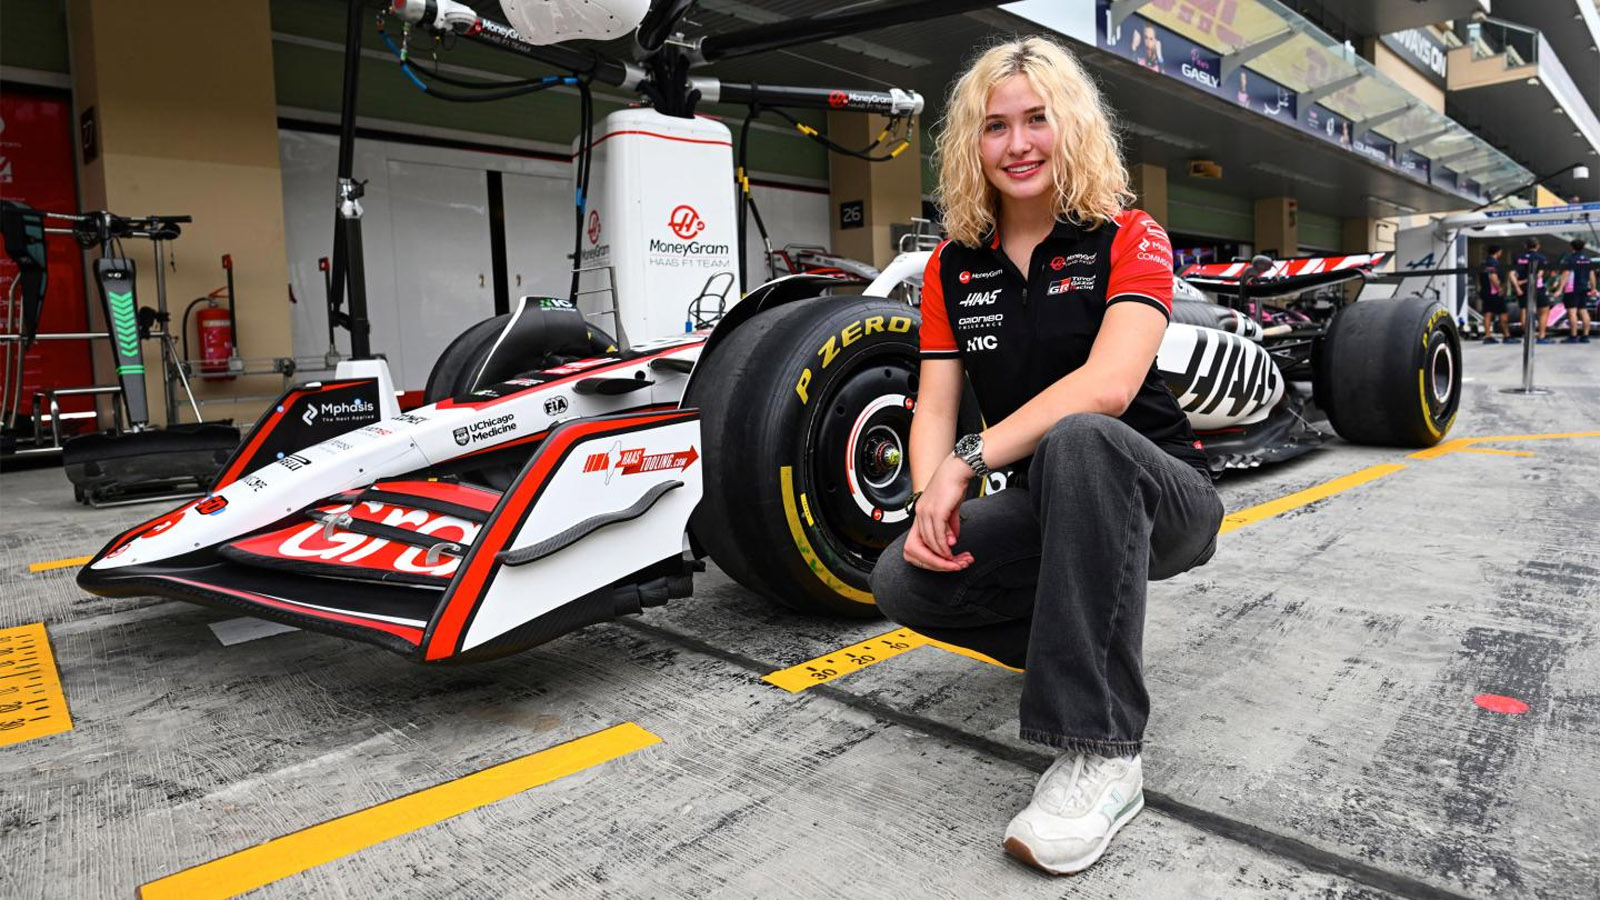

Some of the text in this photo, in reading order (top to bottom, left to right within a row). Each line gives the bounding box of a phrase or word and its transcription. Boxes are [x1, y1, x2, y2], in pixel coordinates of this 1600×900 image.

[482, 18, 524, 42] MoneyGr
[1181, 63, 1219, 88] GASLY
[843, 206, 861, 222] 26
[650, 239, 729, 257] MoneyGram
[651, 258, 680, 267] HAAS
[697, 260, 730, 268] TEAM
[959, 289, 1003, 307] HAAS
[795, 315, 912, 405] P ZERO
[321, 401, 375, 417] Mphasis
[469, 413, 515, 433] UChicago
[472, 422, 518, 443] Medicine
[620, 450, 642, 466] HAAS
[890, 642, 910, 651] 10
[851, 655, 876, 665] 20
[811, 669, 838, 680] 30
